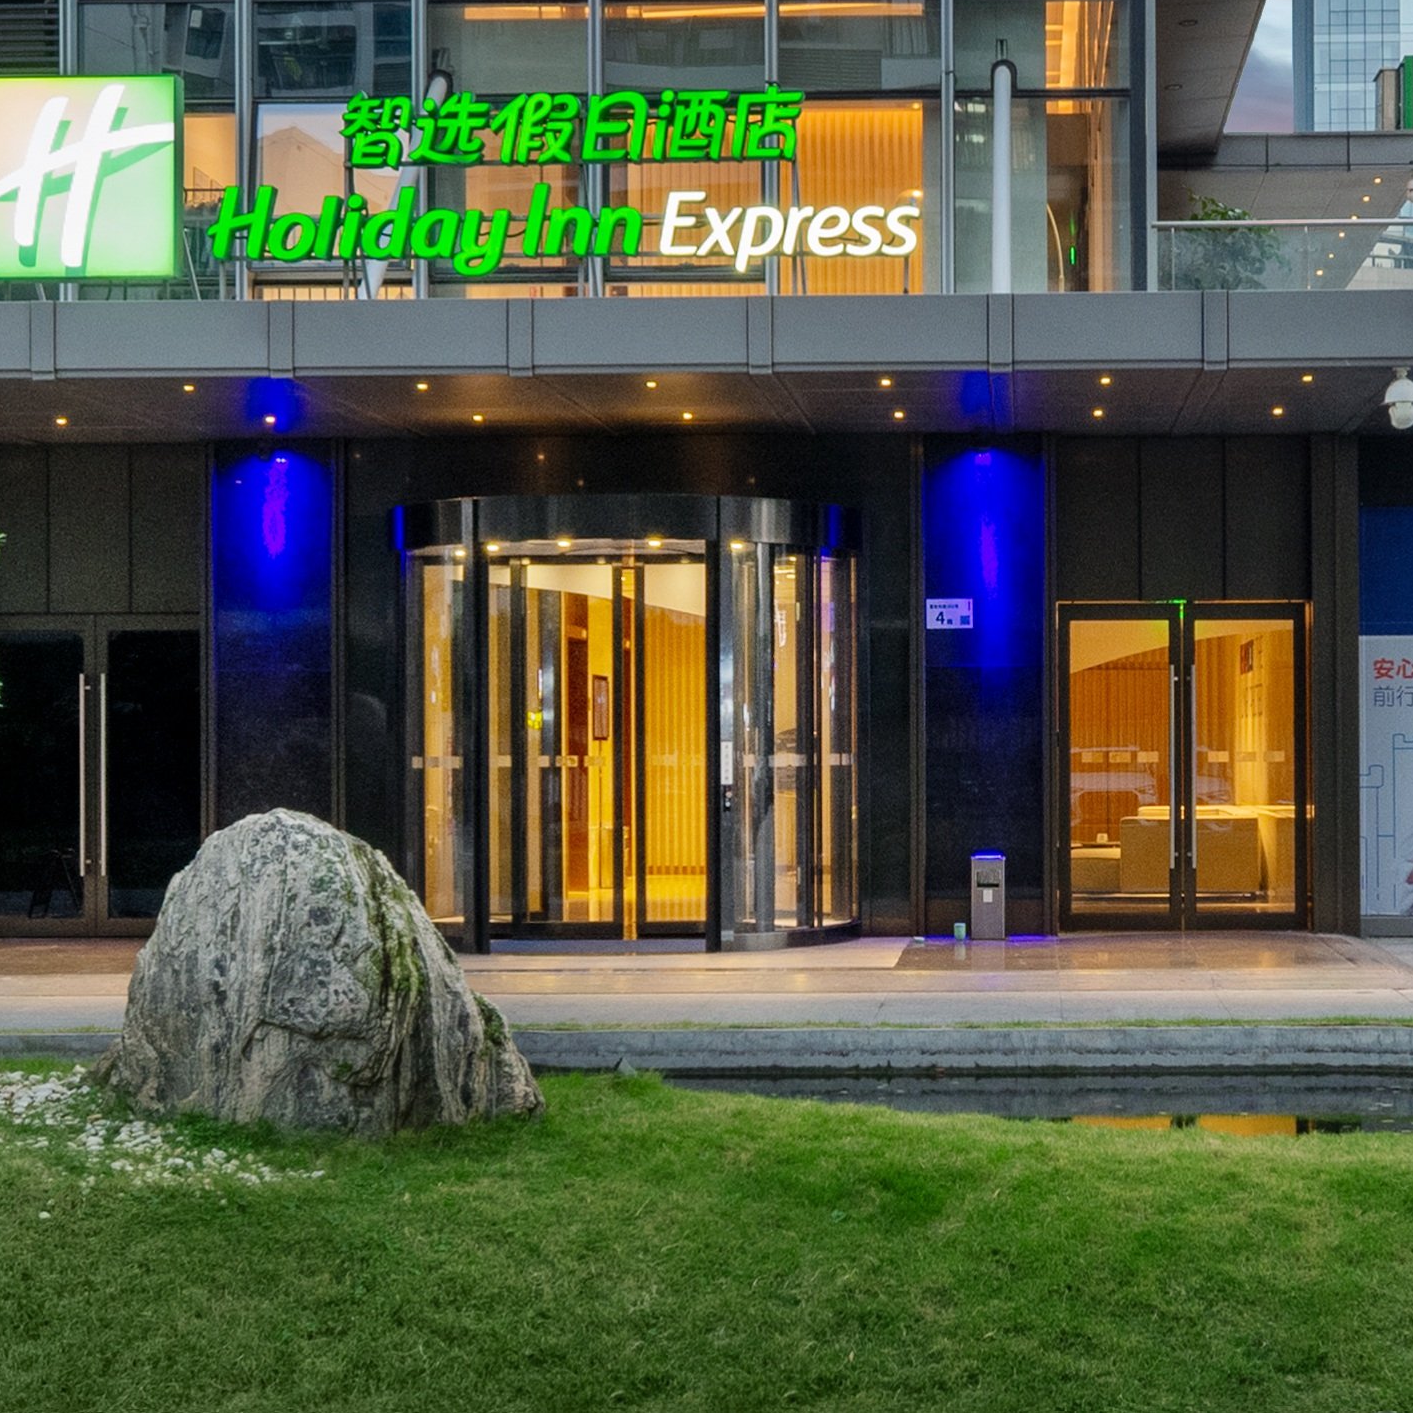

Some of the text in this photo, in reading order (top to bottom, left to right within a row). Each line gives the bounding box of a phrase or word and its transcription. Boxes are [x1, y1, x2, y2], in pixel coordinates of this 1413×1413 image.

[340, 87, 805, 170] 智选假日酒店
[207, 182, 921, 277] Holiday Inn Express
